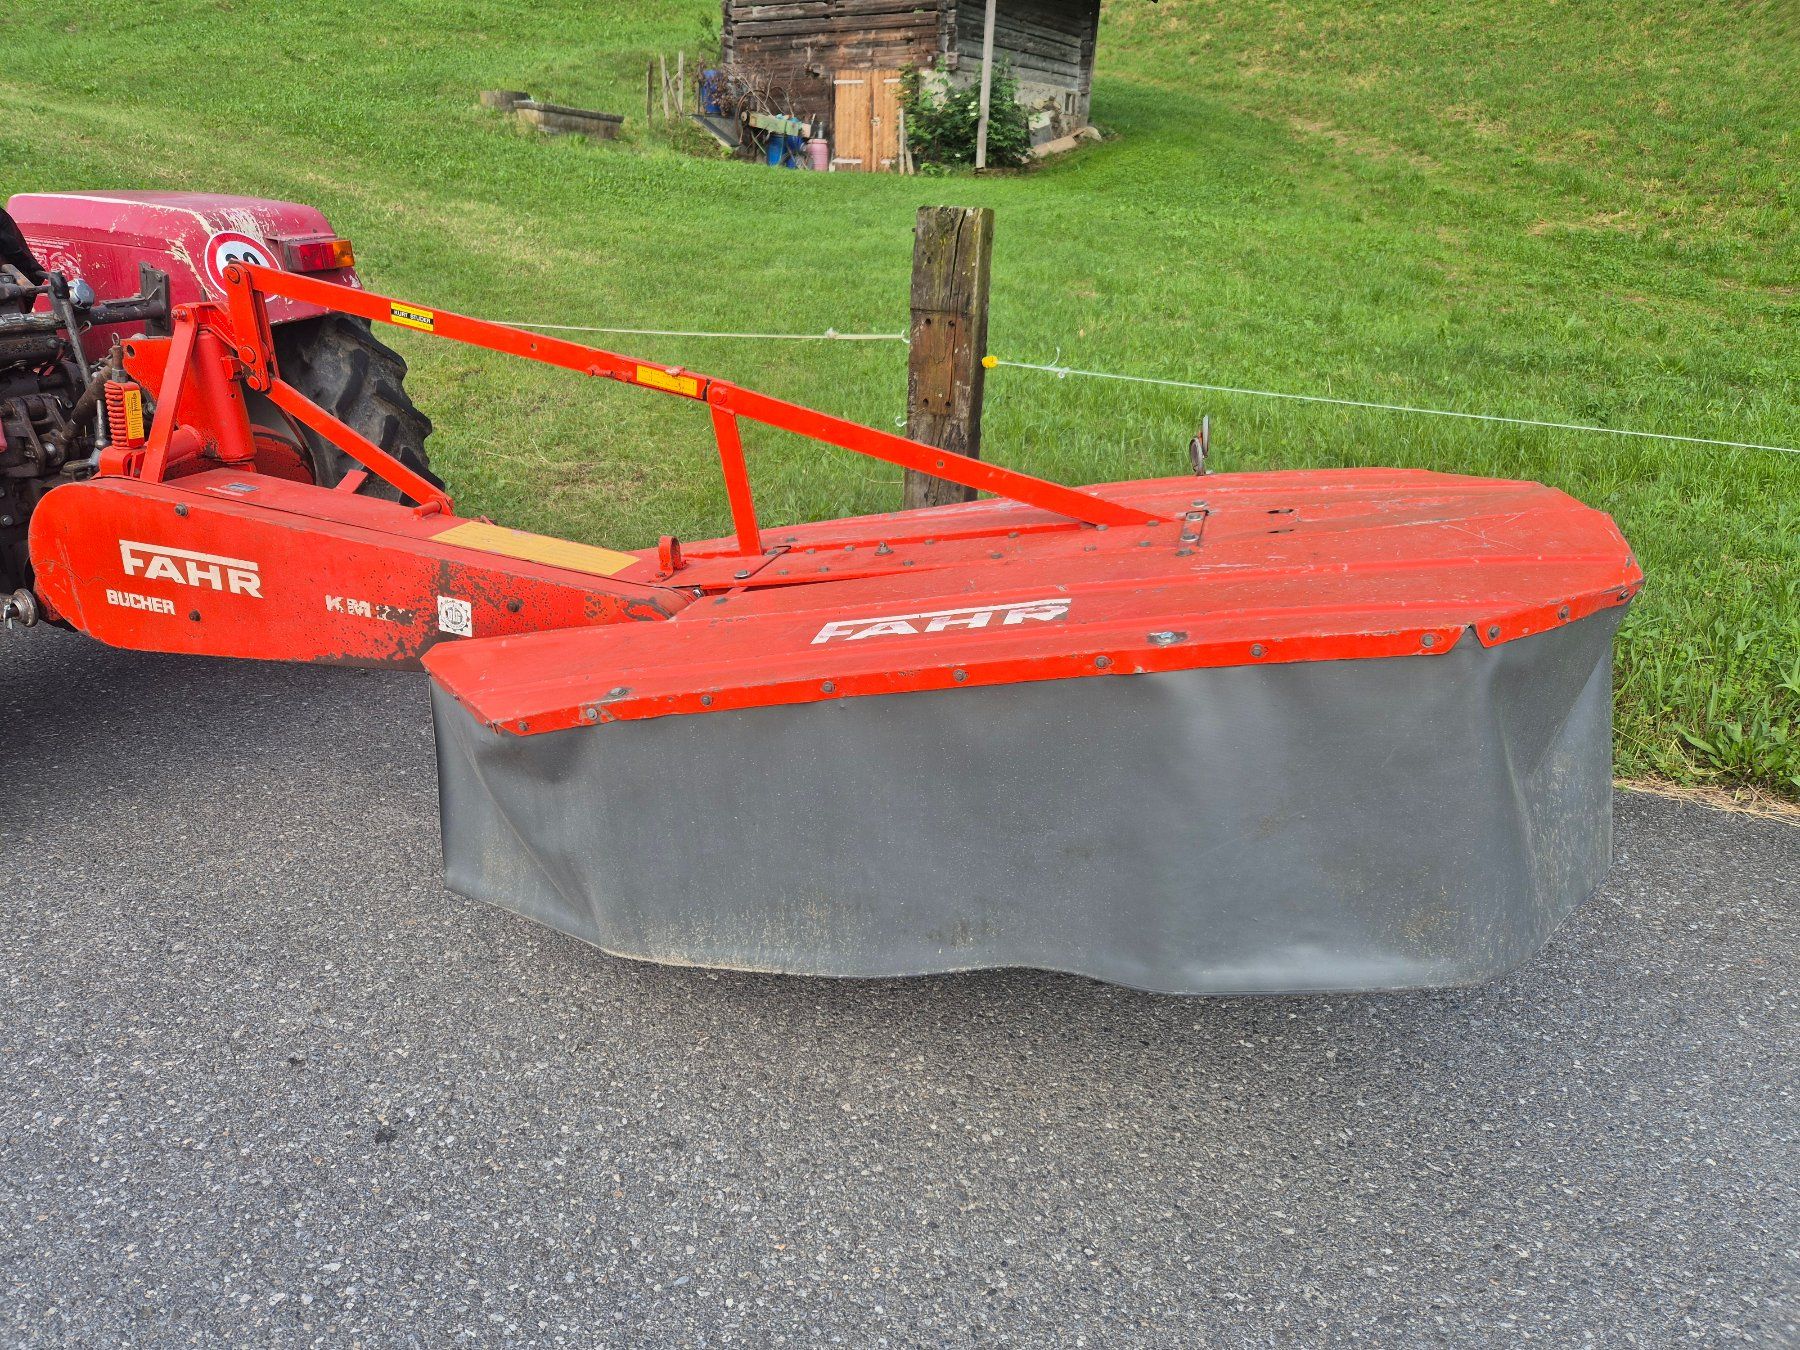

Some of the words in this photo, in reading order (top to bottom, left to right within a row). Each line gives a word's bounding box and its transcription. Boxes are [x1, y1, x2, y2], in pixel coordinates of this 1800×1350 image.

[393, 309, 408, 318] KURT
[118, 539, 264, 599] FAHR
[105, 588, 177, 616] BUCHER
[810, 597, 1072, 644] FAHR
